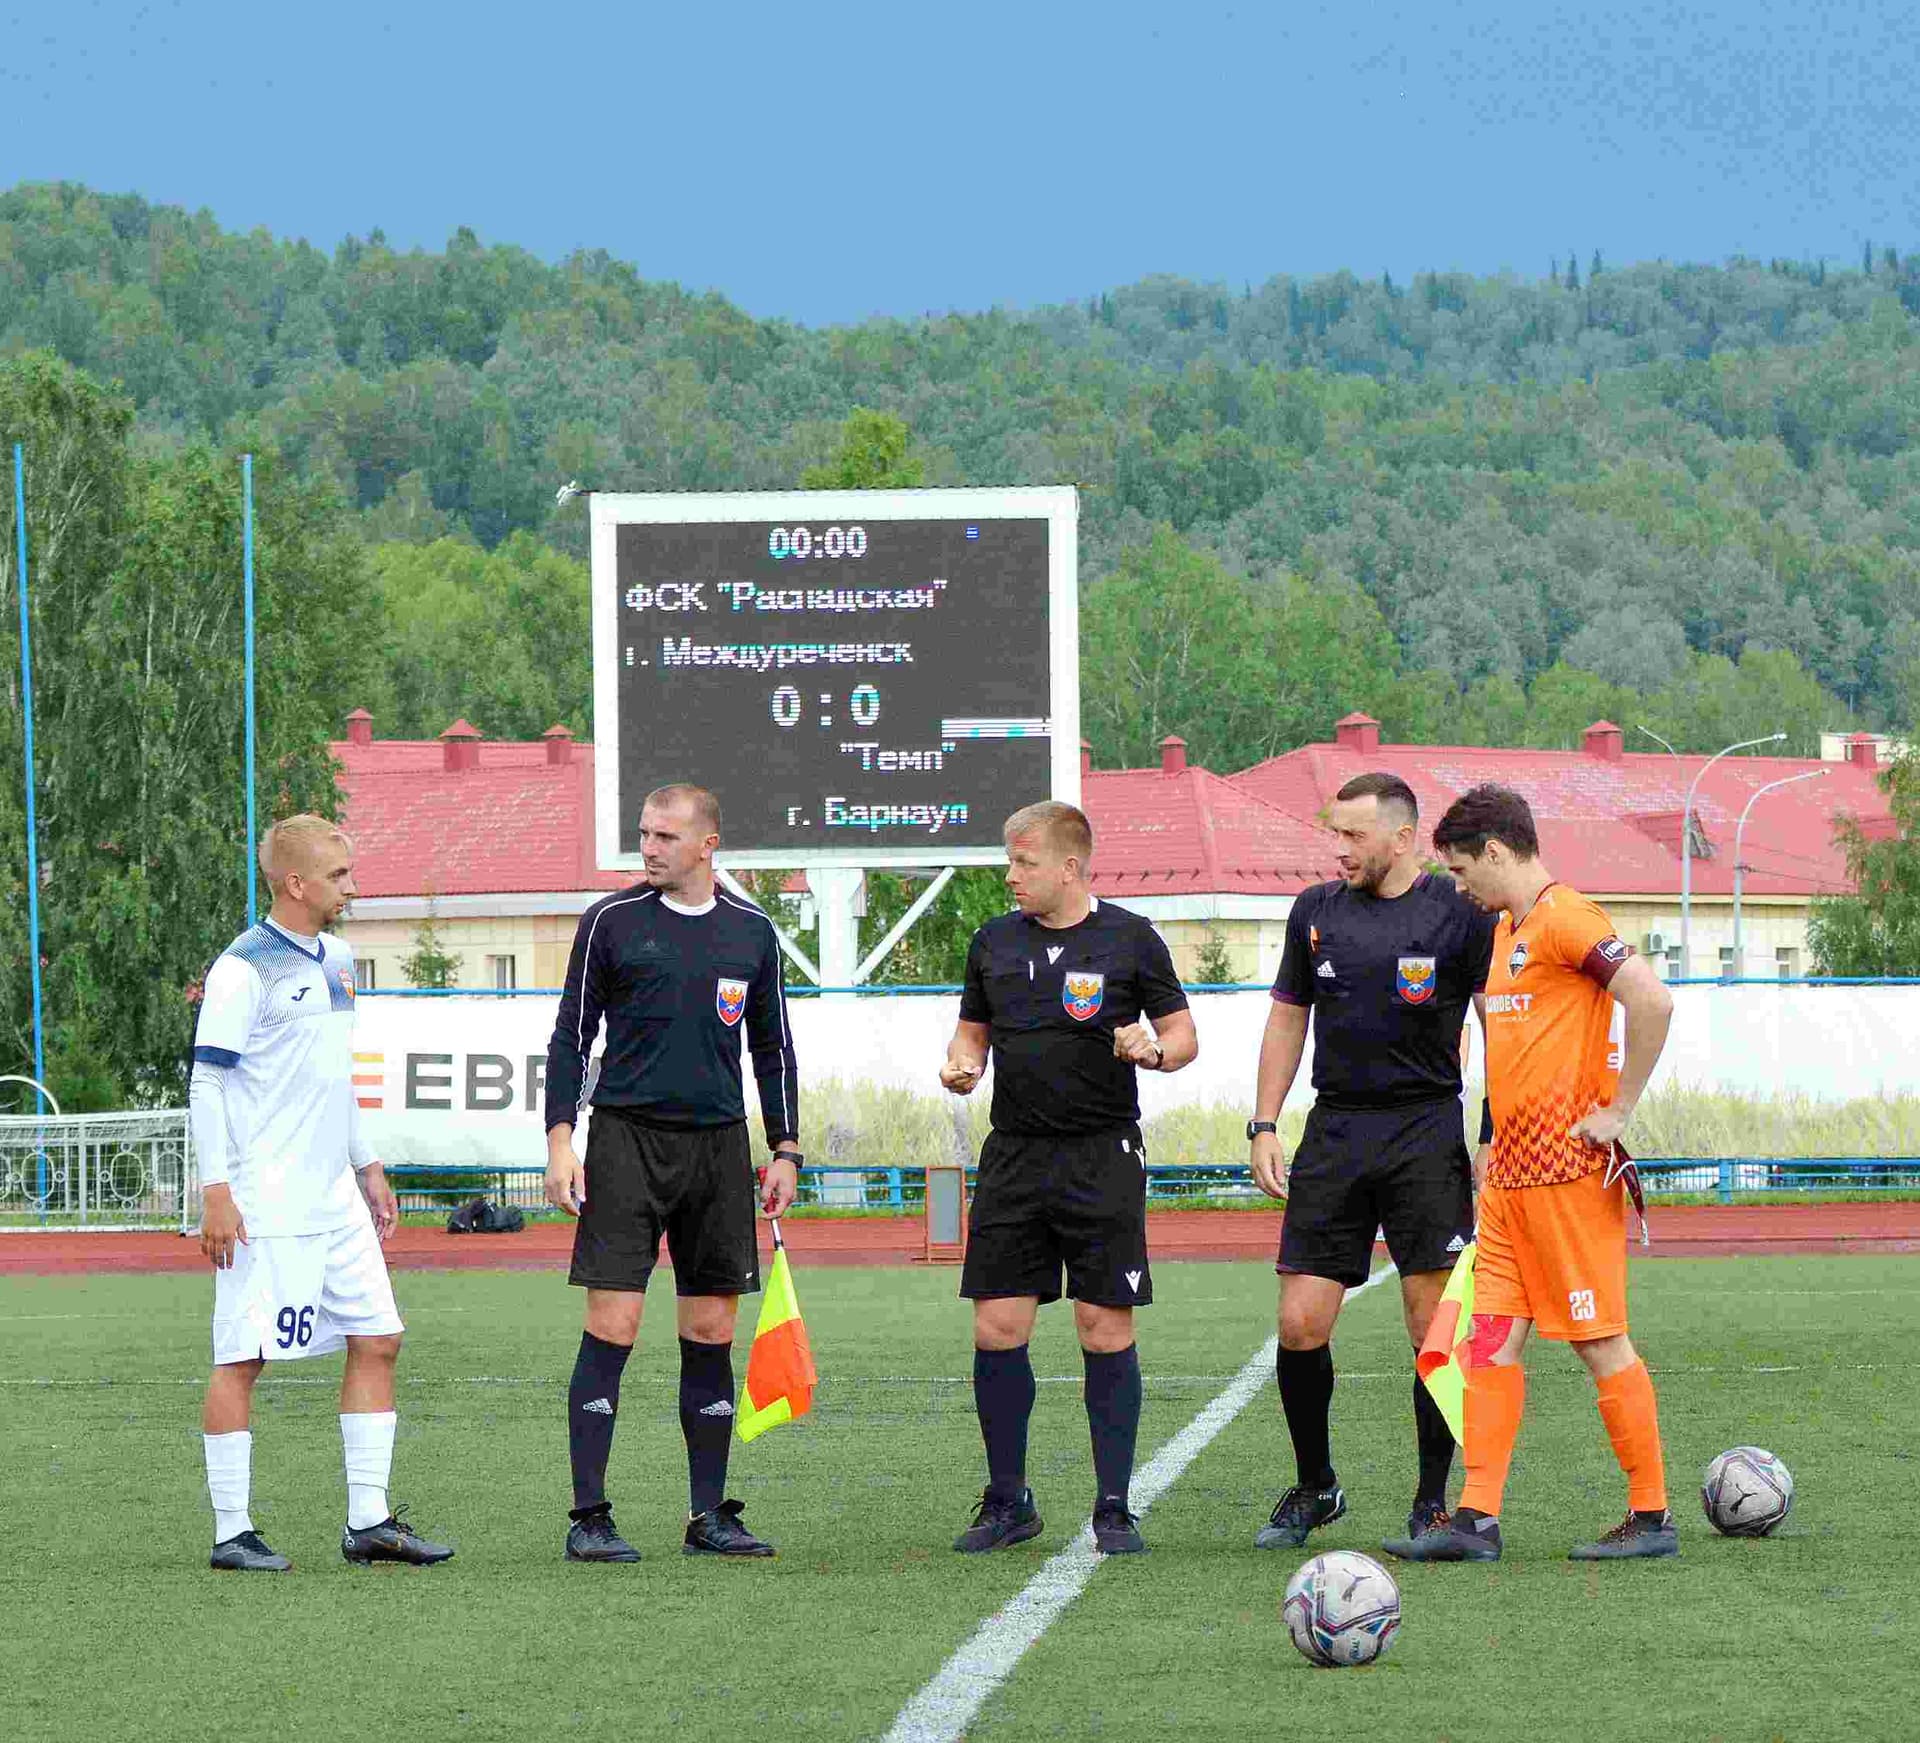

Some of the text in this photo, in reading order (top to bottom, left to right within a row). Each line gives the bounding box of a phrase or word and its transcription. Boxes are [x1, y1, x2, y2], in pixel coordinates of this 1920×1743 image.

[768, 527, 867, 558] 00:00
[625, 583, 708, 611] ФСК
[662, 637, 913, 672] Междуреченск
[825, 797, 968, 833] Барнаул
[1569, 1289, 1595, 1320] 23
[276, 1305, 314, 1349] 96
